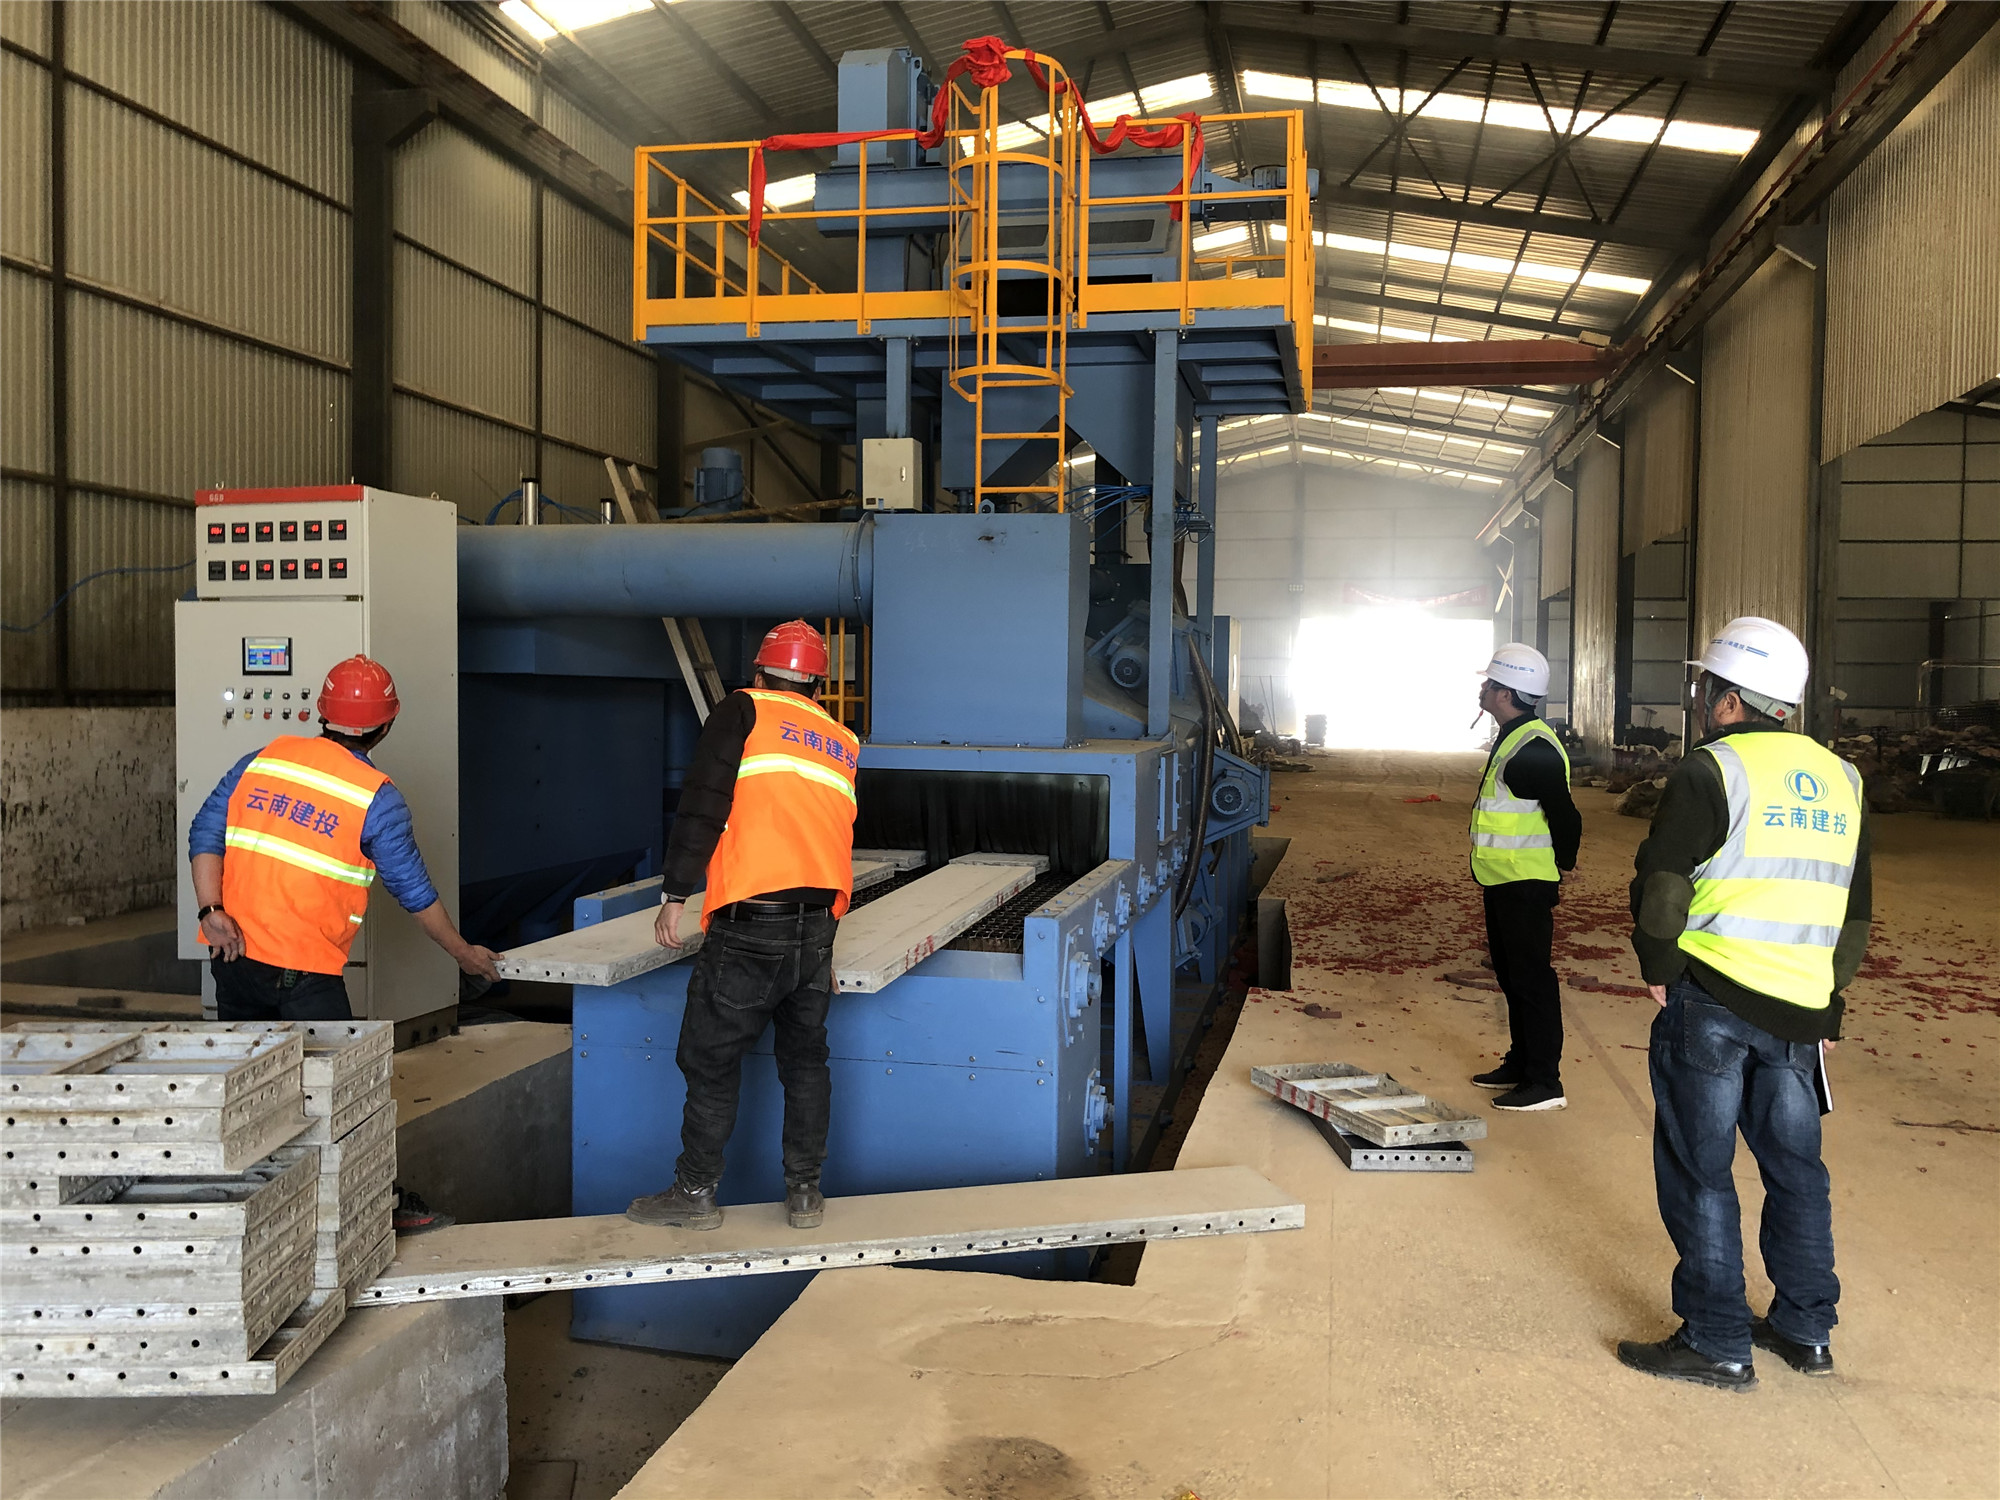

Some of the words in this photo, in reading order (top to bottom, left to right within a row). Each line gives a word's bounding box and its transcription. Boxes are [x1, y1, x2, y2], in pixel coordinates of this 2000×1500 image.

[246, 788, 339, 838] 云南建投
[1762, 806, 1847, 836] 云南建投
